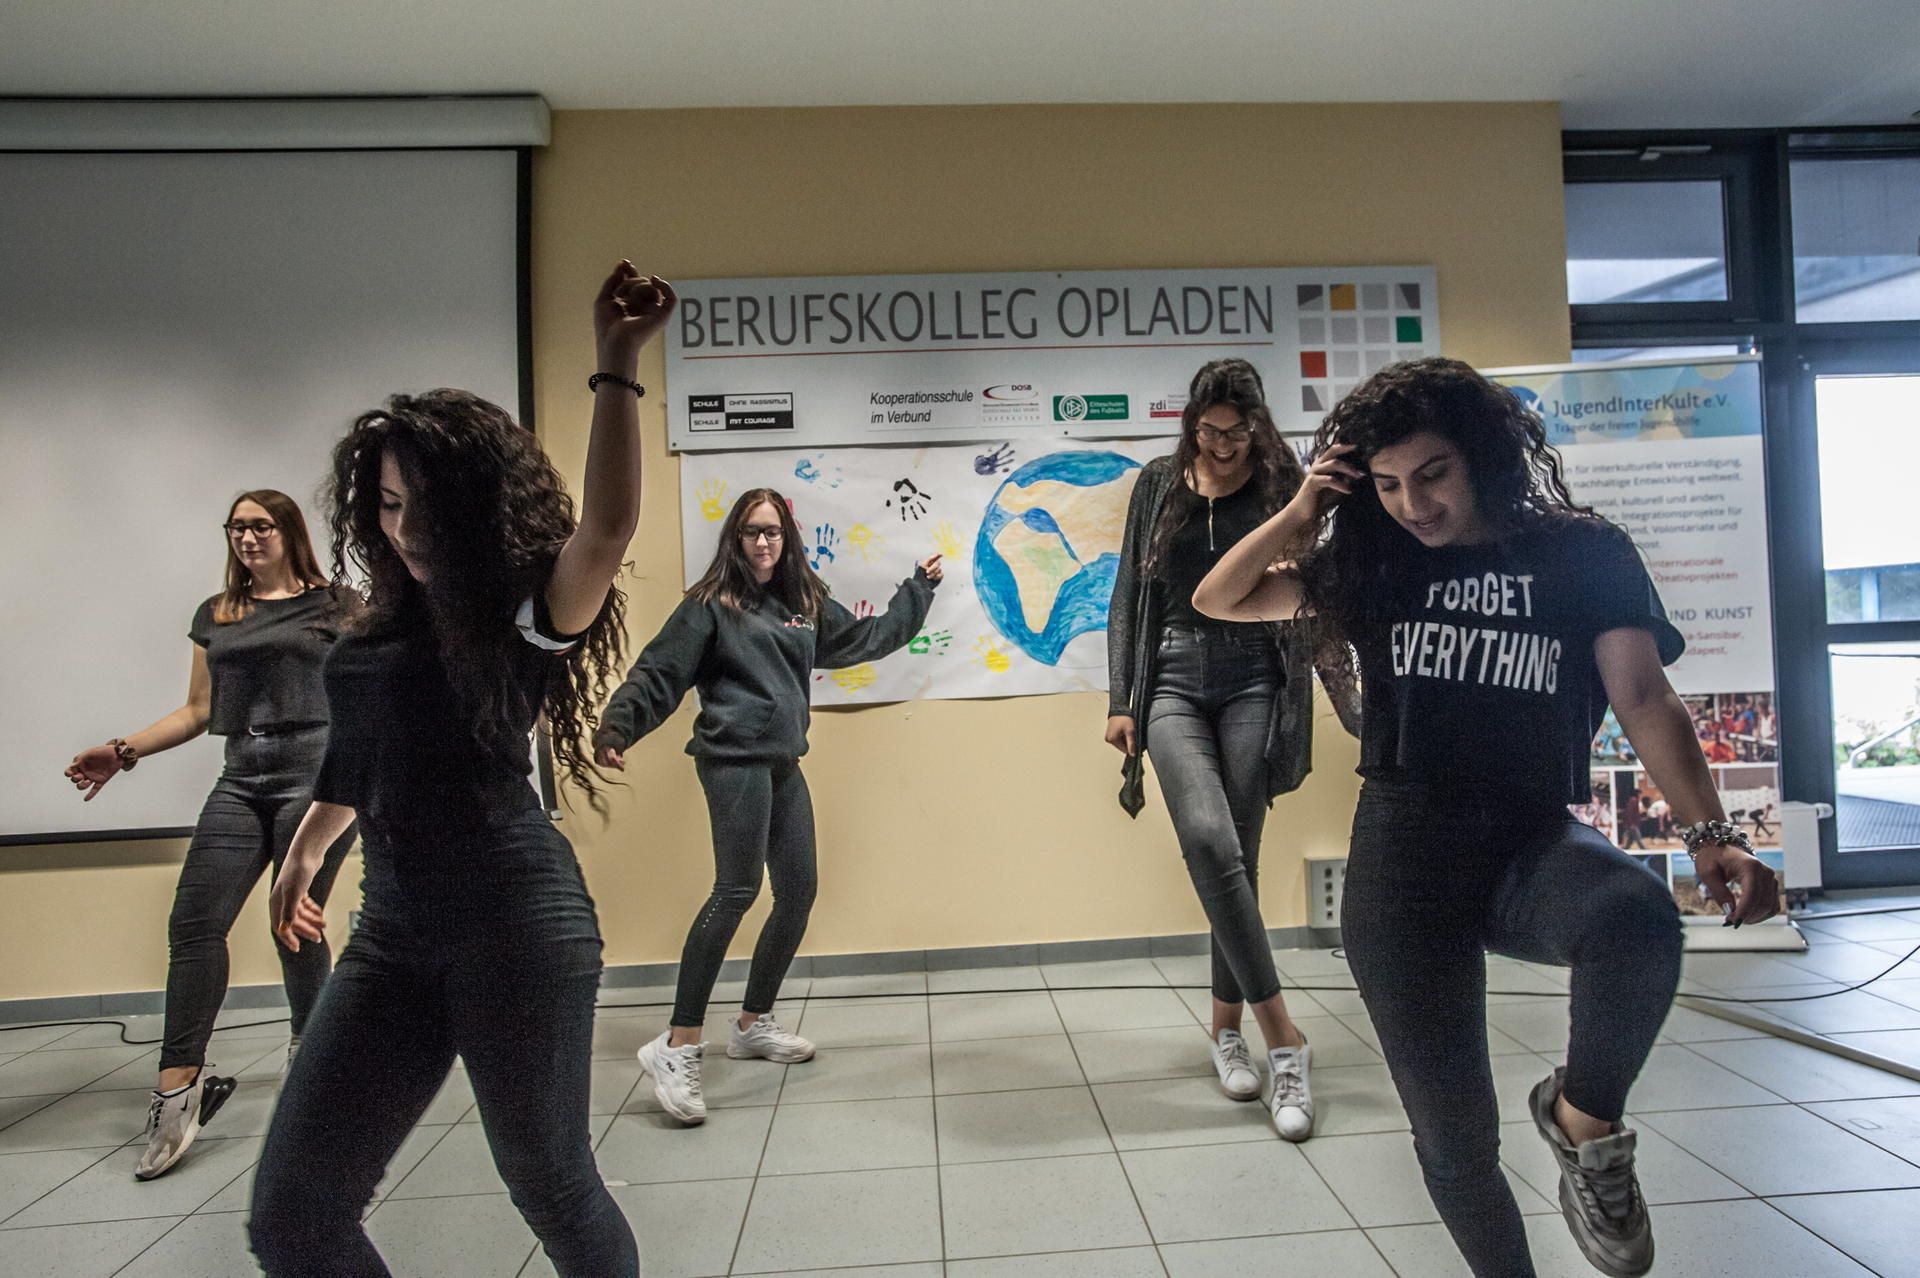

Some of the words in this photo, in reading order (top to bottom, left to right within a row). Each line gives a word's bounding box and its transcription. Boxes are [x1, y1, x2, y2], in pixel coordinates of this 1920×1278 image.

[680, 288, 1038, 348] BERUFSKOLLEG
[1057, 285, 1273, 338] OPLADEN
[692, 400, 719, 408] SCHULE
[870, 390, 974, 407] Kooperationsschule
[1149, 400, 1166, 410] zdi
[1554, 392, 1699, 418] JugendInterKult
[871, 412, 884, 423] im
[887, 410, 932, 424] Verbund
[1666, 494, 1687, 504] und
[1690, 492, 1725, 503] anders
[1718, 521, 1738, 531] und
[1425, 572, 1533, 617] FORGET
[1705, 606, 1754, 620] KUNST
[1391, 621, 1562, 695] EVERYTHING
